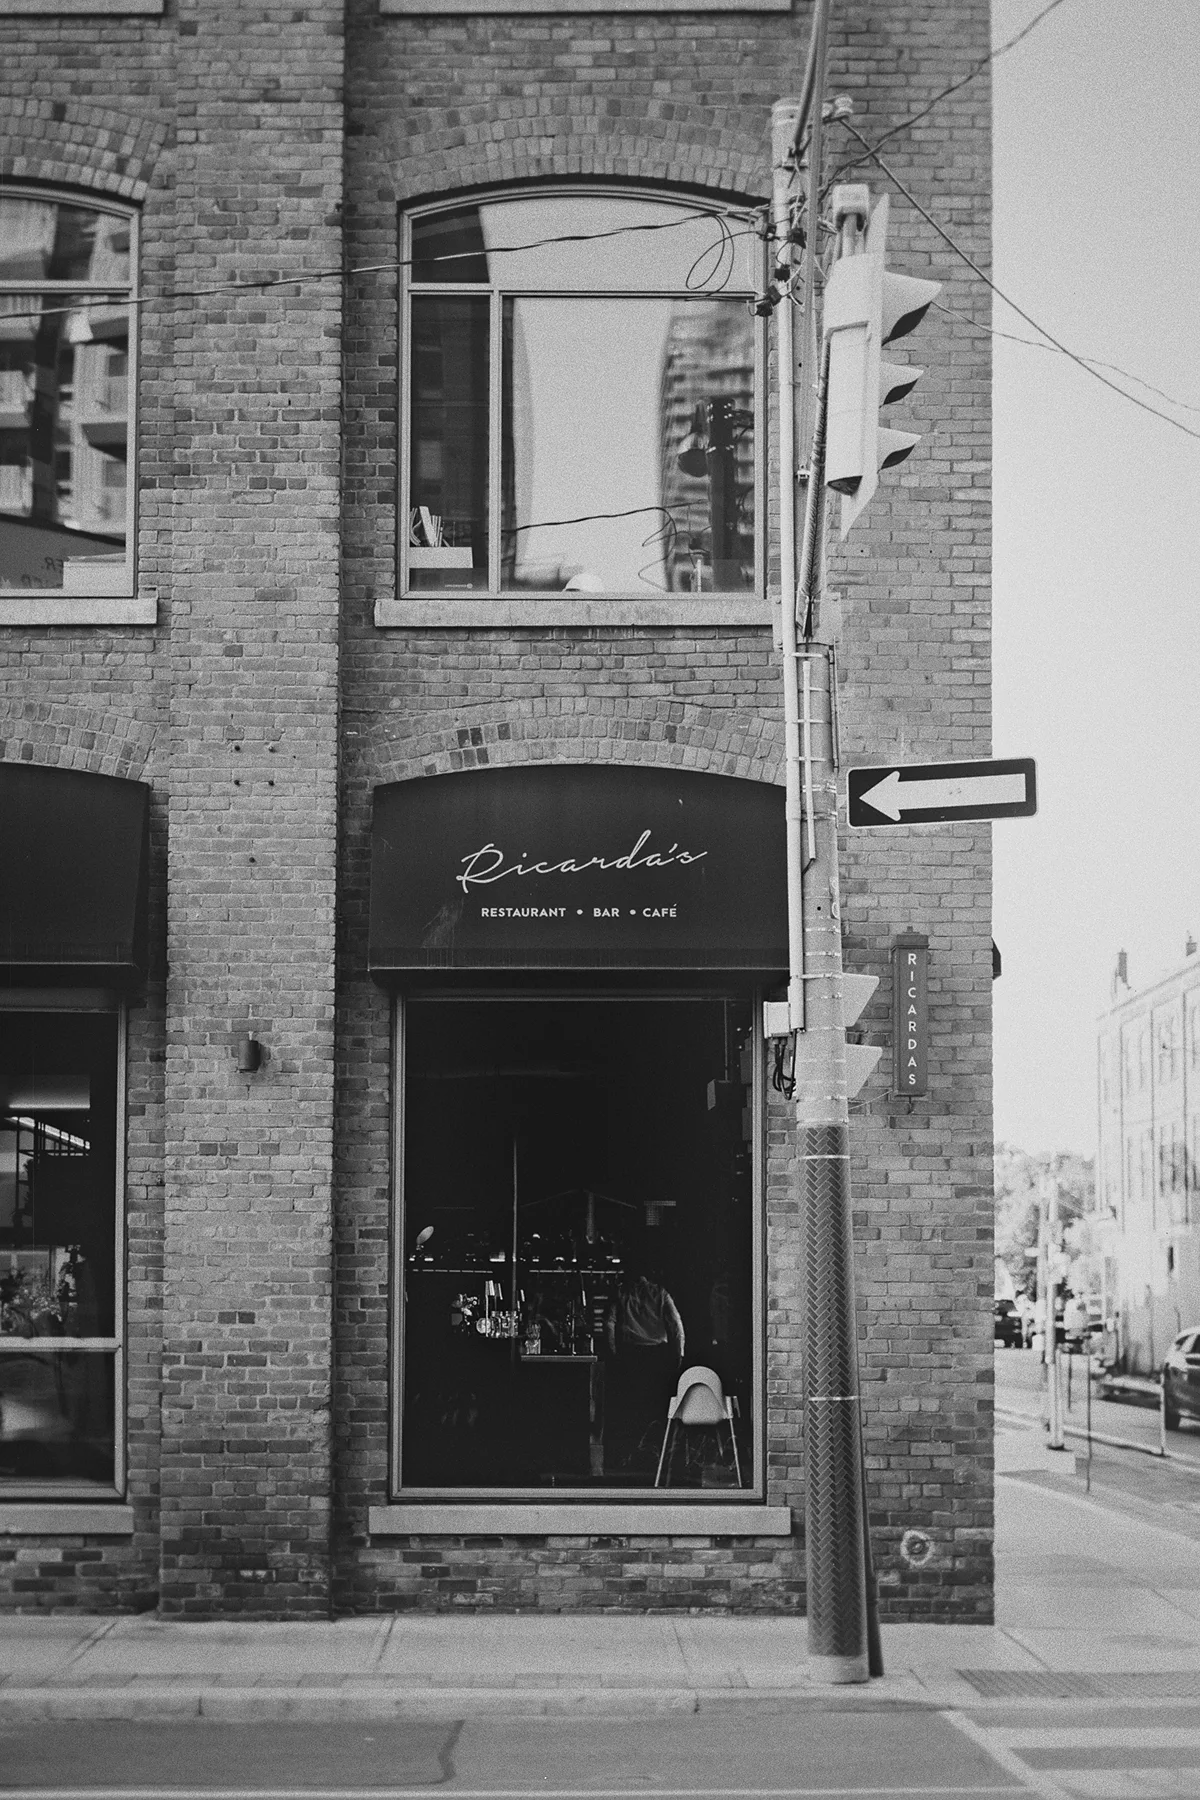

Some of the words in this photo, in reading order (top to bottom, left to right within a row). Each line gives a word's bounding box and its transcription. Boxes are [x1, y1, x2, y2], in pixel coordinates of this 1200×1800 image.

[456, 829, 708, 893] Ricarda's
[481, 907, 567, 918] RESTAURANT
[593, 907, 620, 918] BAR
[642, 903, 678, 918] CAFÉ
[907, 953, 918, 1085] RICARDAS
